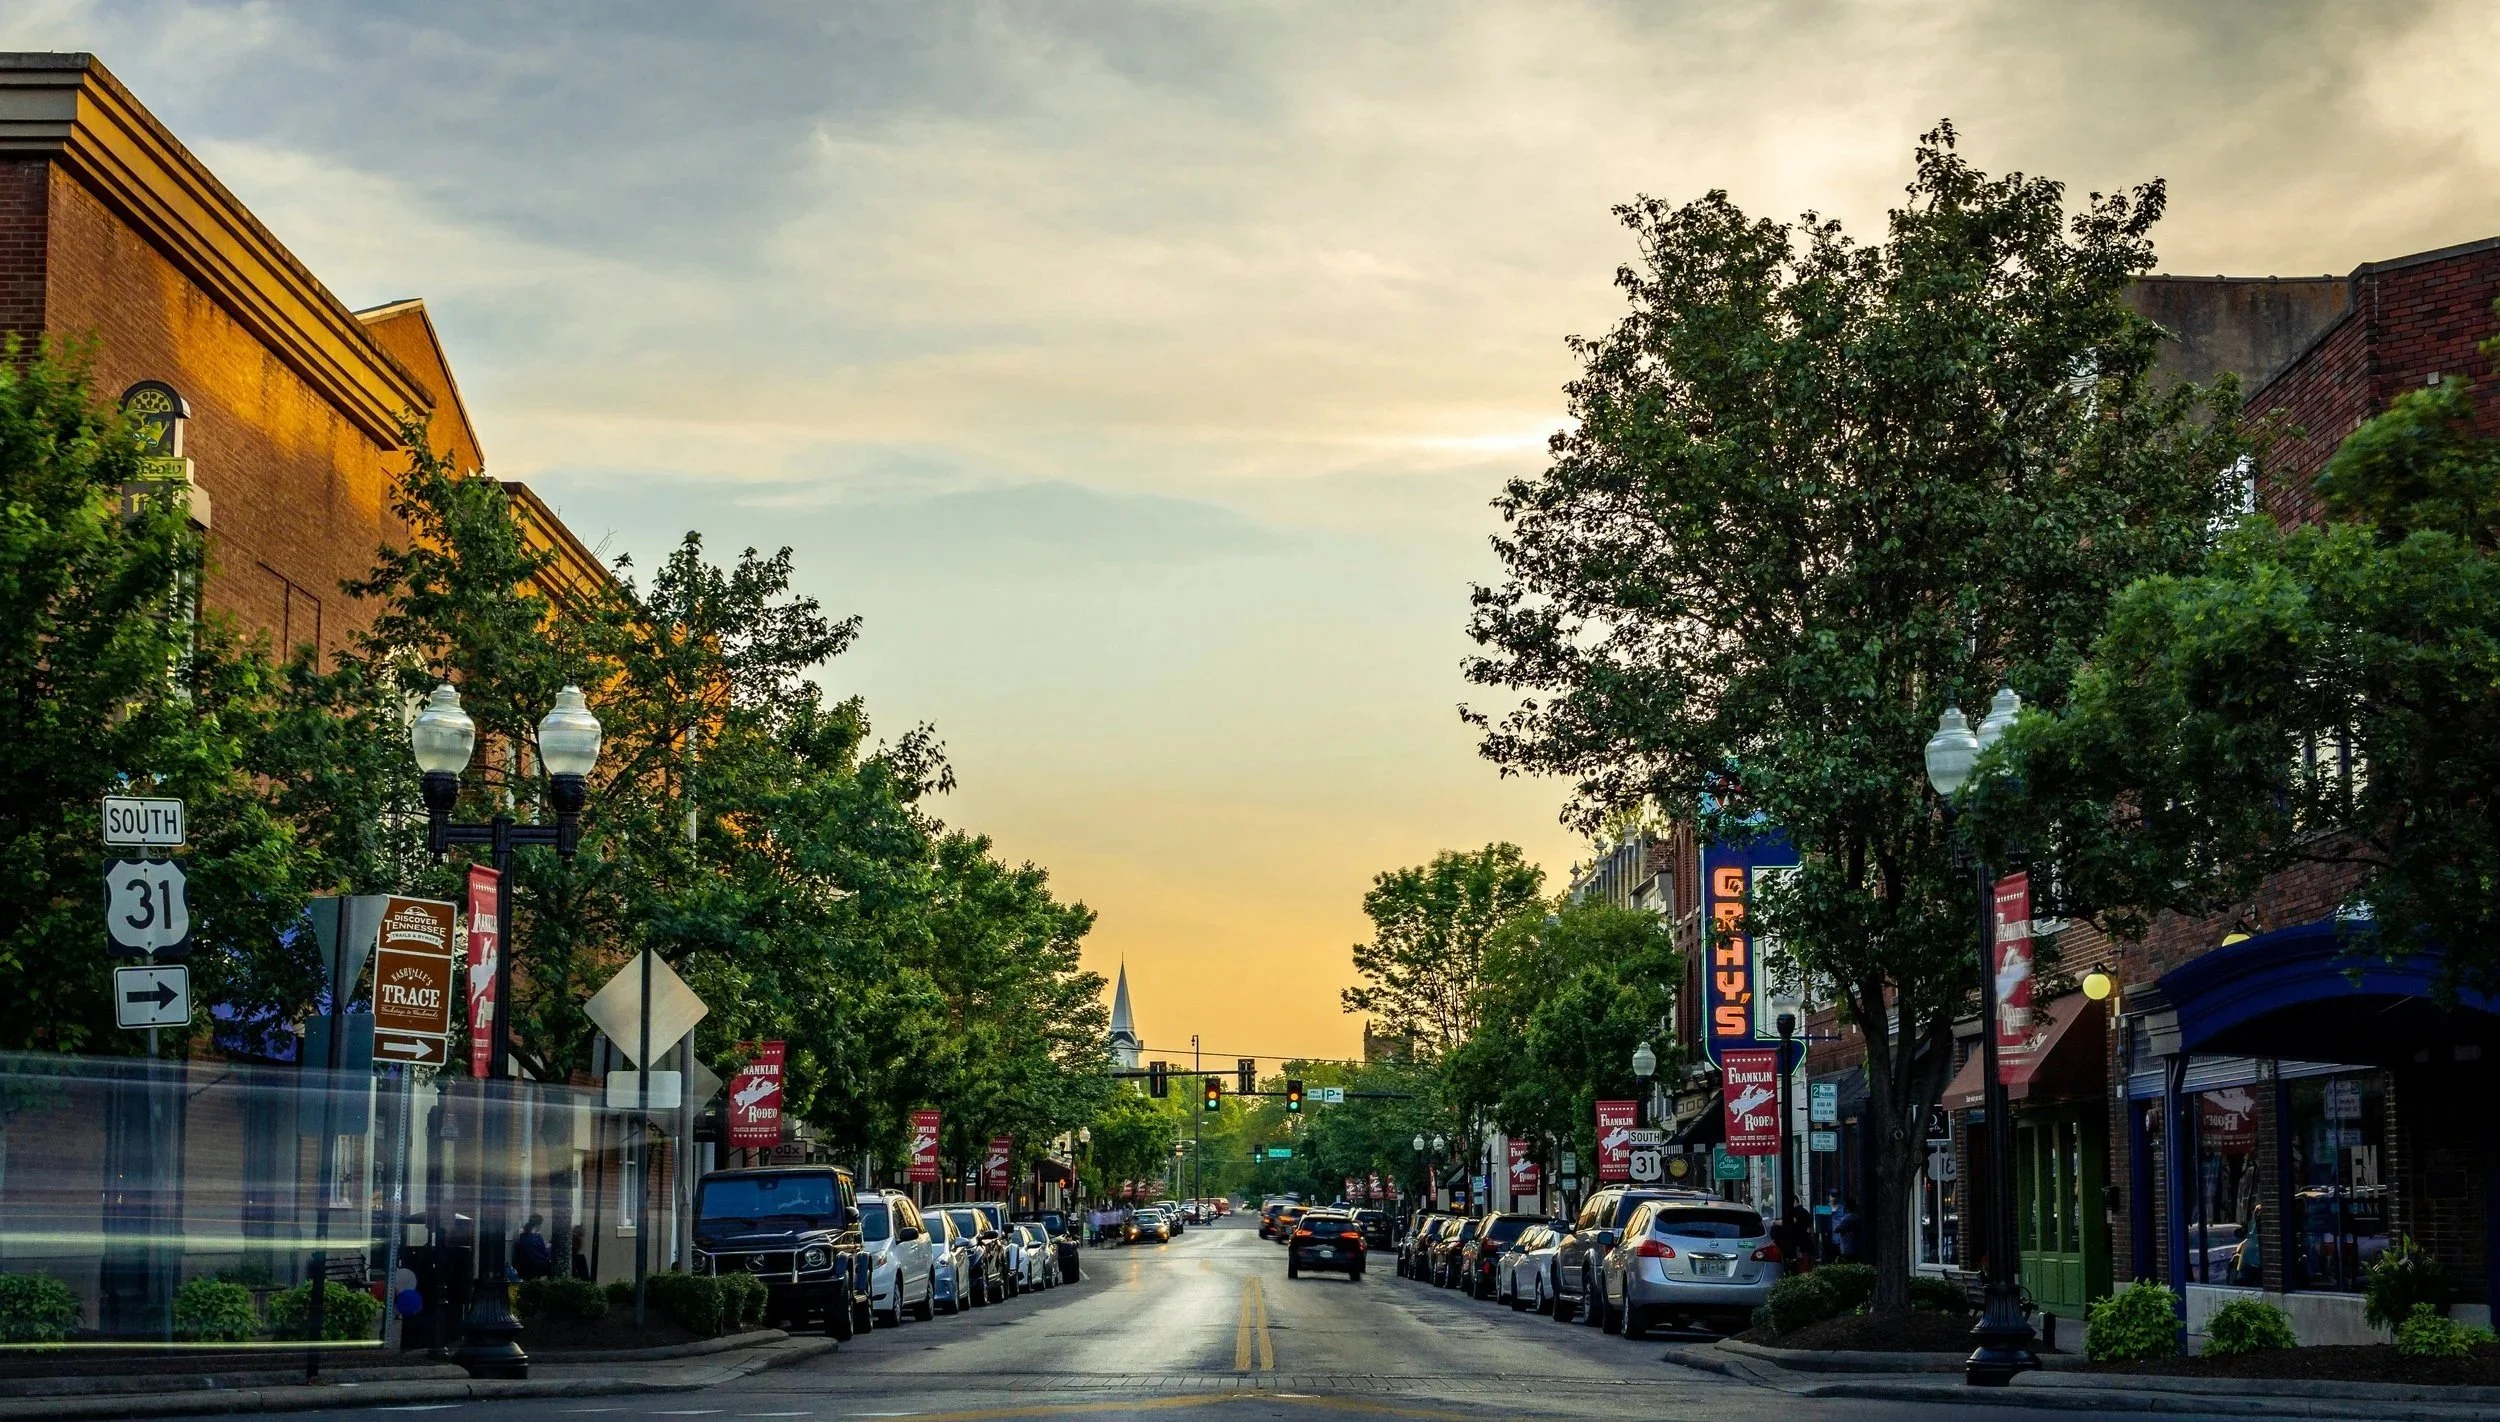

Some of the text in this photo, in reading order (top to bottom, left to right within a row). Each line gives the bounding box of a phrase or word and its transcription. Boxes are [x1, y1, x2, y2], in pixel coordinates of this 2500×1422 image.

[110, 808, 177, 834] SOUTH
[126, 879, 171, 930] 31
[384, 920, 447, 937] TENNESSEE
[394, 914, 438, 926] DISCOVER
[418, 935, 439, 943] BYWAYS
[1714, 867, 1751, 1036] GRAY'S
[391, 967, 433, 986] NASHVILLE'S
[382, 984, 440, 1008] TRACE
[741, 1064, 779, 1075] RANKLIN
[1728, 1067, 1772, 1084] FRANKLIN
[1327, 1090, 1335, 1100] P
[1813, 1087, 1819, 1097] 2
[748, 1105, 777, 1122] RODEO
[1600, 1114, 1633, 1126] FRANKLIN
[1744, 1114, 1774, 1131] RODEO
[1630, 1132, 1660, 1142] SOUTH
[915, 1153, 934, 1165] RODEO
[1635, 1156, 1655, 1173] 31
